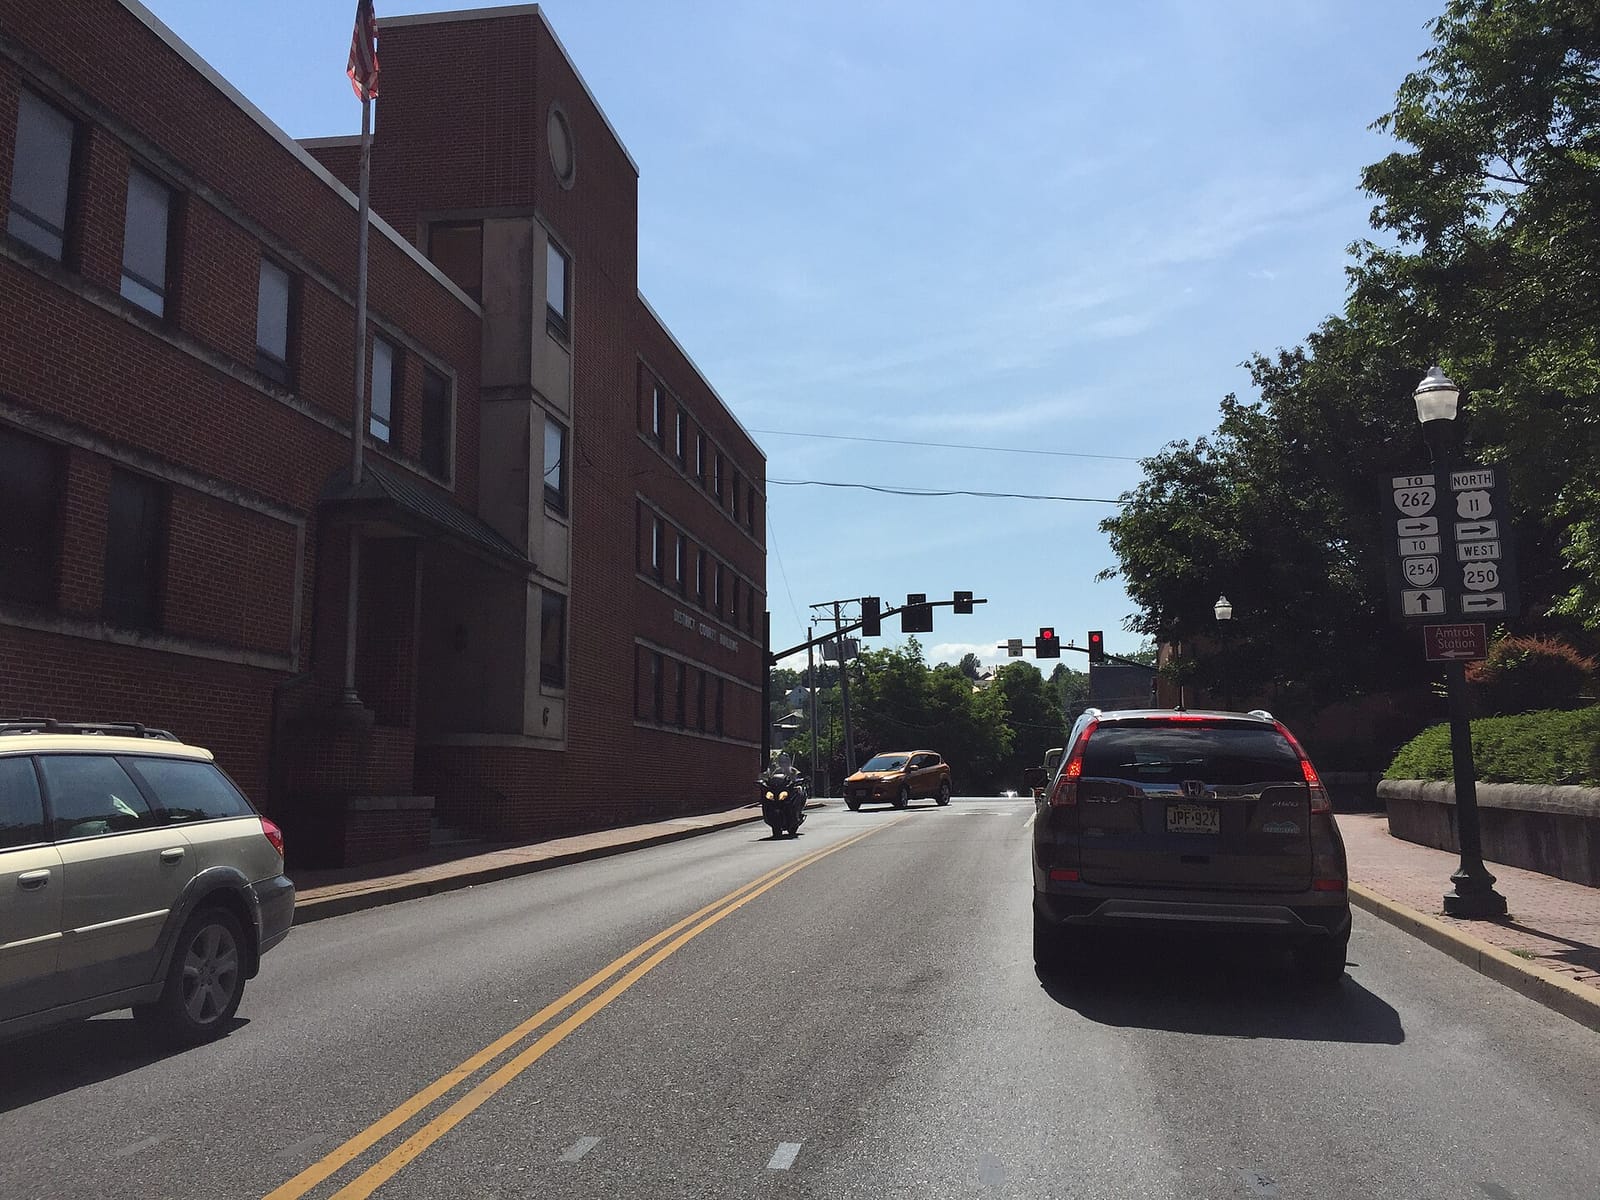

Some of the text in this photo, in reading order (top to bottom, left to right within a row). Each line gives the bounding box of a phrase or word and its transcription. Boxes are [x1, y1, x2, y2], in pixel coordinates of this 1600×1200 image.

[1406, 477, 1423, 486] TO
[1453, 473, 1491, 487] NORTH
[1401, 491, 1430, 508] 262
[1469, 499, 1479, 512] 11
[1412, 540, 1426, 551] TO
[1463, 544, 1495, 557] WEST
[1408, 563, 1434, 576] 254
[1466, 569, 1495, 584] 250
[1435, 625, 1476, 638] Amtrak
[1438, 638, 1475, 649] Station
